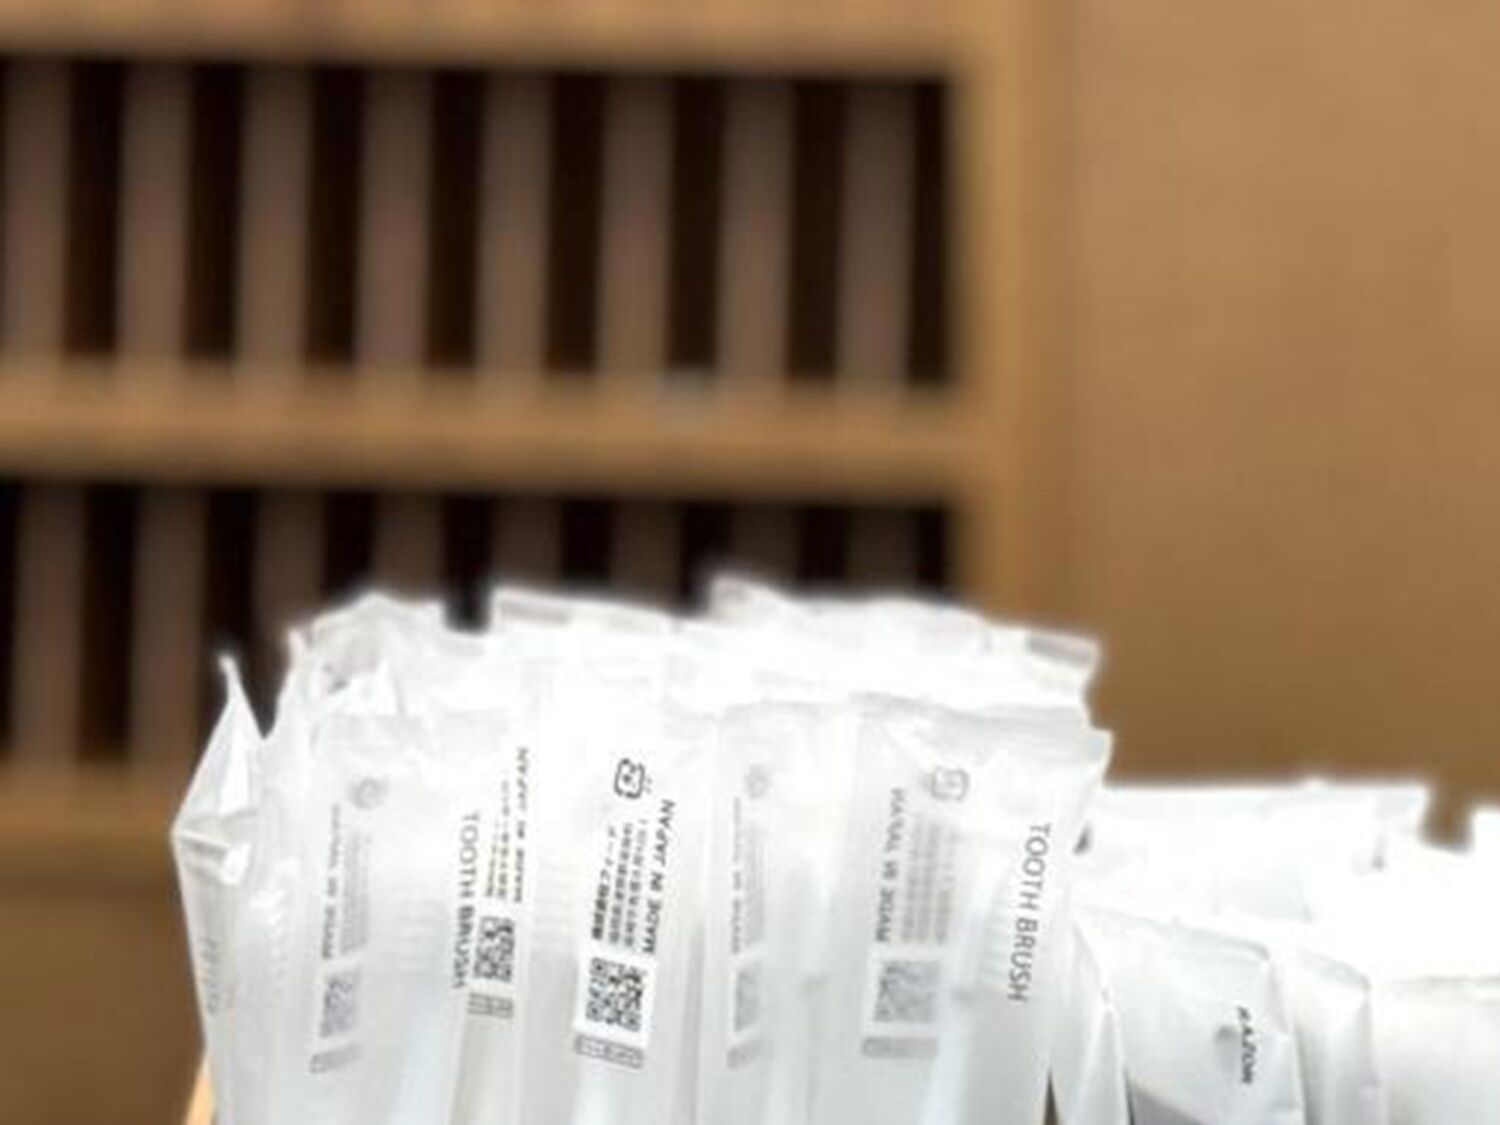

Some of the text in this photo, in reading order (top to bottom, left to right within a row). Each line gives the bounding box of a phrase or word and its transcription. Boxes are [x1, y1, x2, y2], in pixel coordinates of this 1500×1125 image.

[453, 811, 479, 989] TOOTH BRUSH
[641, 799, 677, 954] MADE IN JAPAN
[1007, 822, 1052, 1002] TOOTH BRUSH
